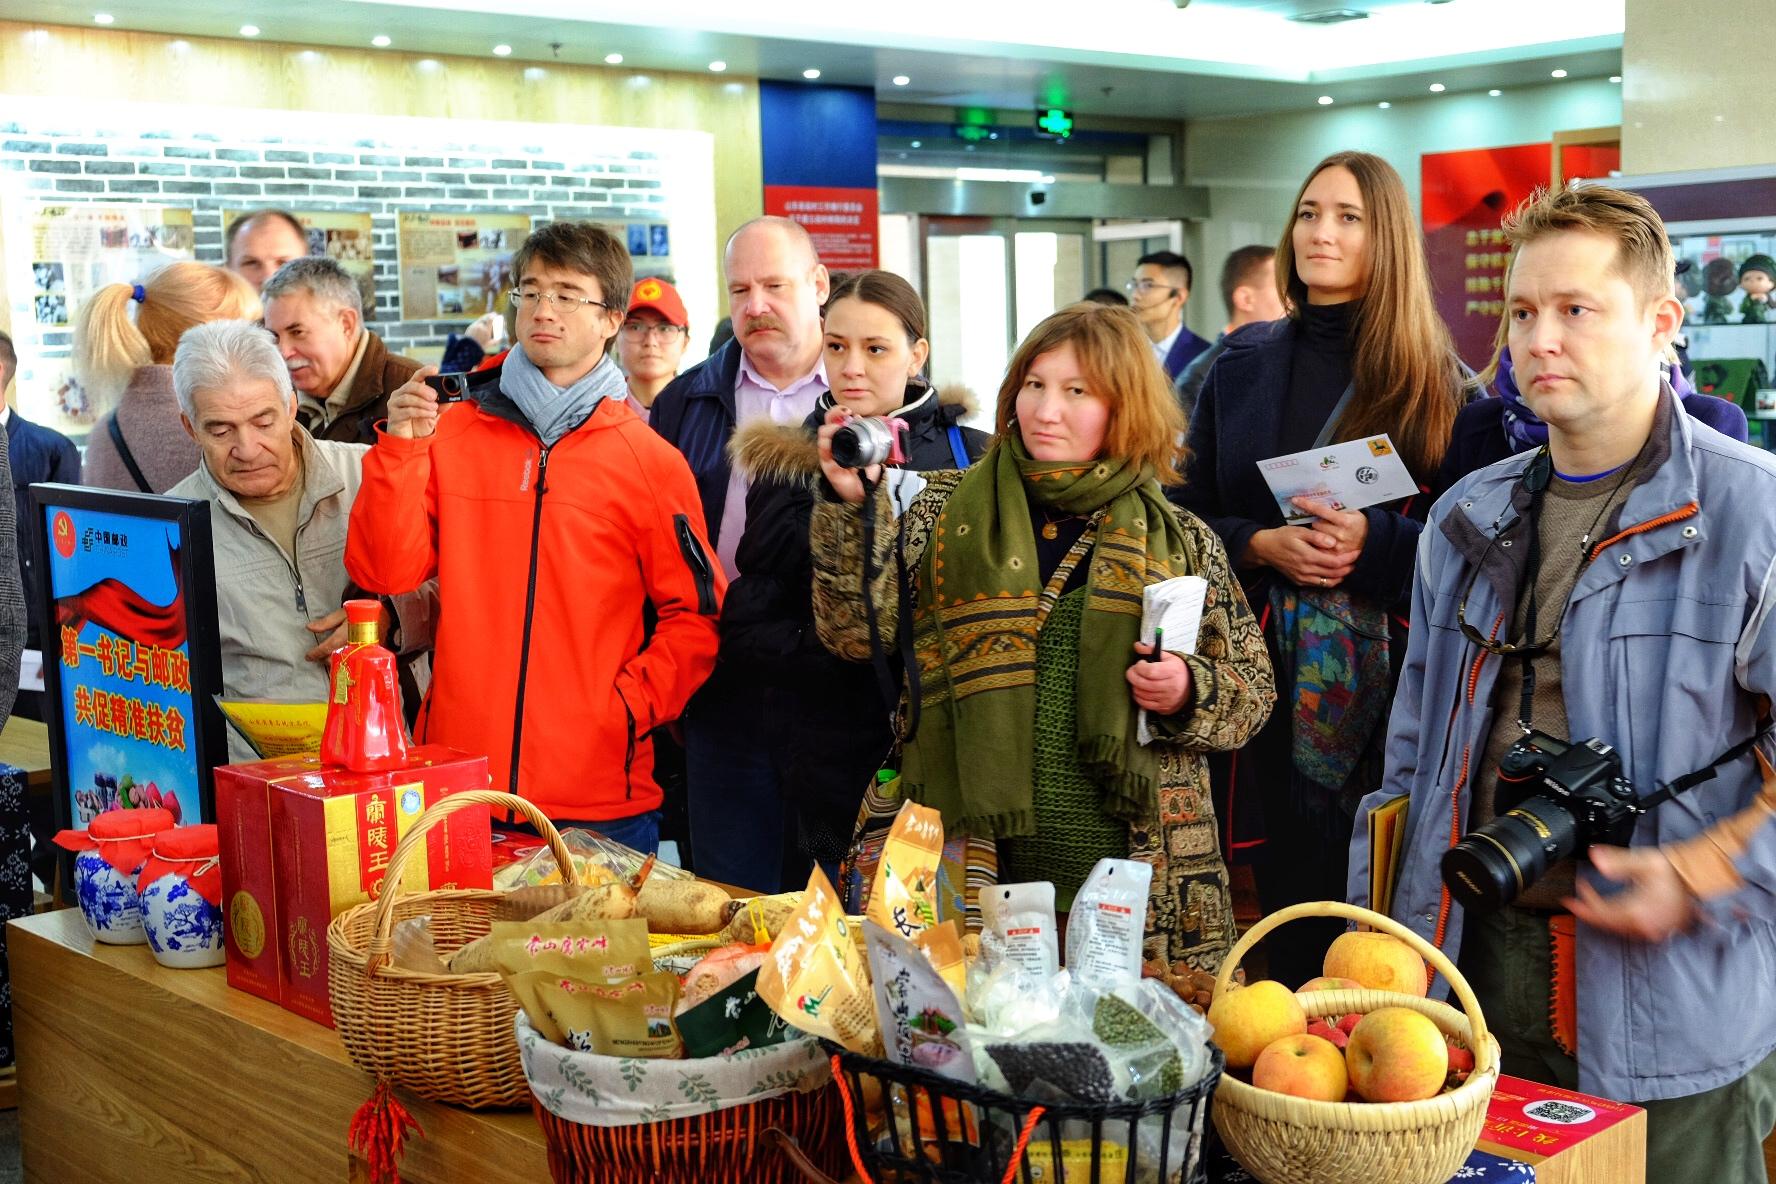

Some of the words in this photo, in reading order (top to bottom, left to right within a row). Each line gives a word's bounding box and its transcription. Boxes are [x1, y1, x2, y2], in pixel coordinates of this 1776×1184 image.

[95, 531, 128, 548] 中国邮政
[61, 626, 191, 692] 第一书记与邮政
[75, 687, 185, 750] 共促精准扶贫
[1543, 777, 1571, 796] Nikon
